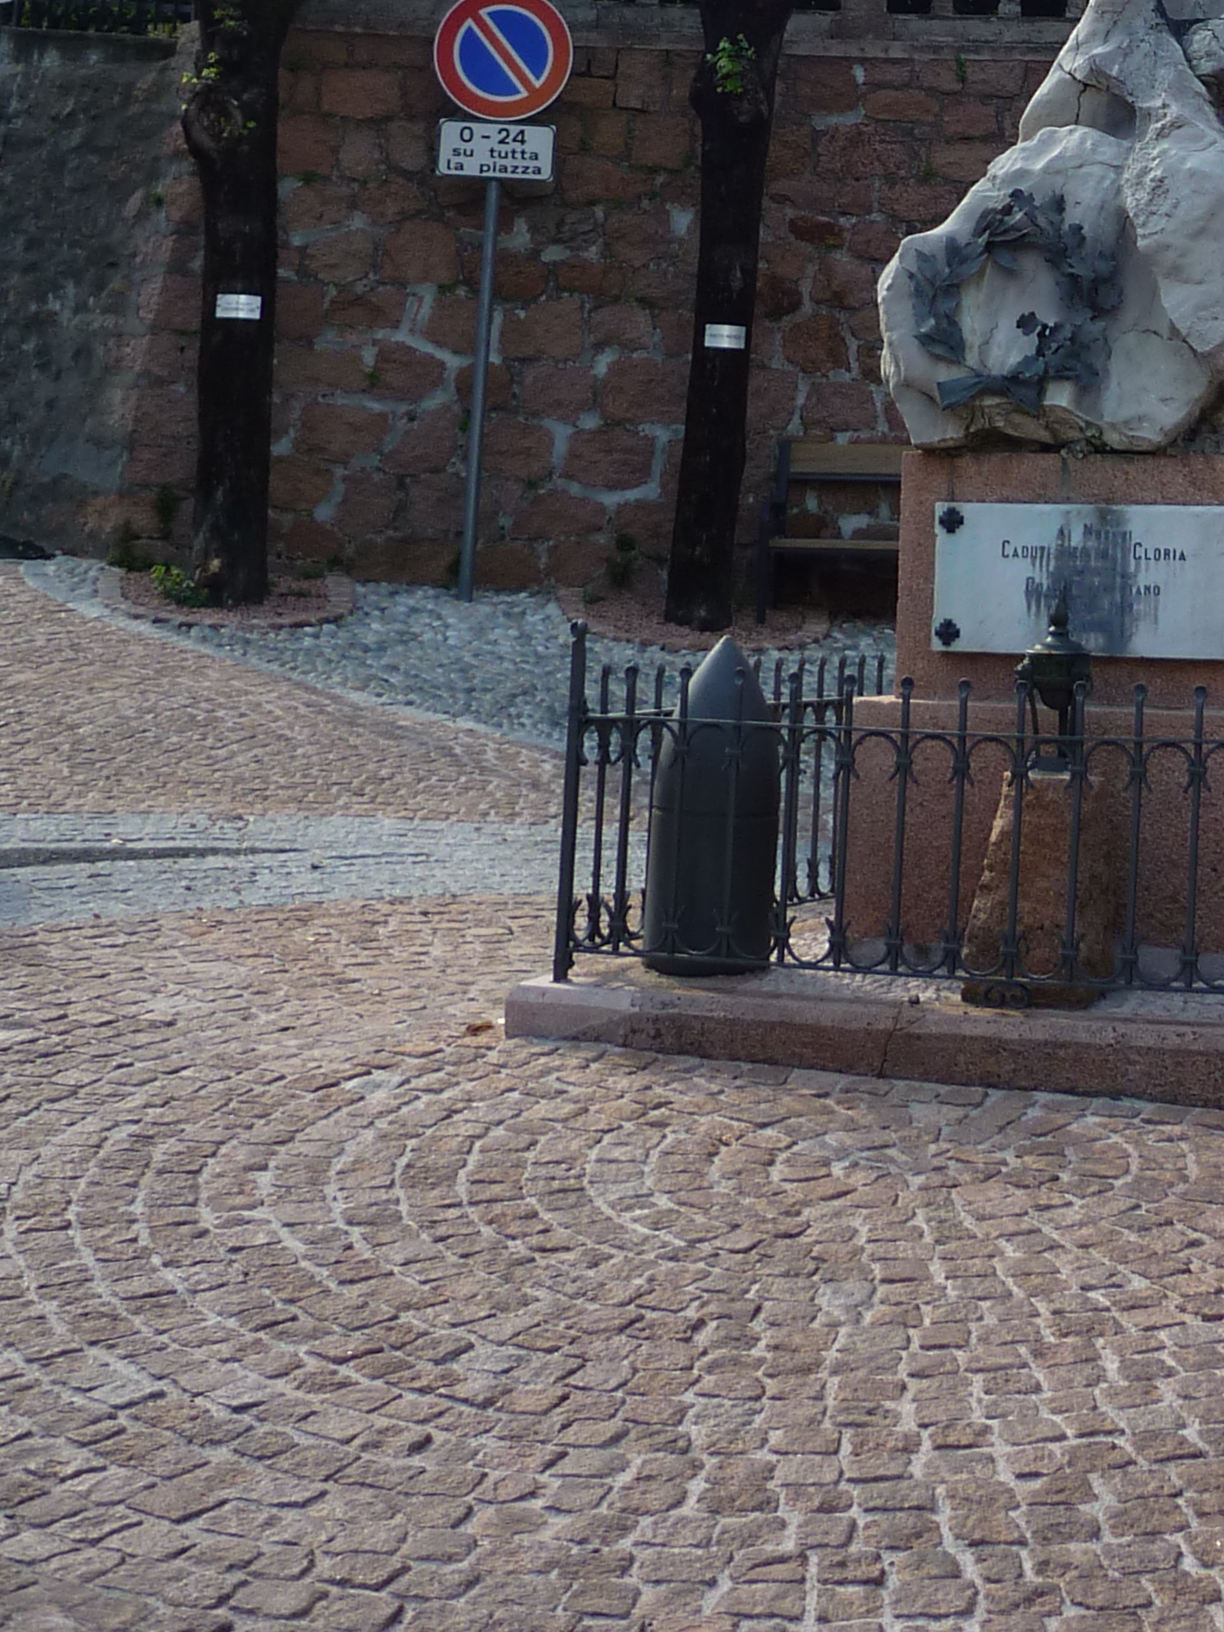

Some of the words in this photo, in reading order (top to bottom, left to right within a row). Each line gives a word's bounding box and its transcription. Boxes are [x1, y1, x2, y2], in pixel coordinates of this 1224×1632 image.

[459, 126, 474, 143] 0
[497, 128, 527, 146] 24
[452, 147, 474, 158] su
[489, 147, 539, 161] tutta
[446, 158, 465, 172] la
[479, 161, 542, 175] piazza
